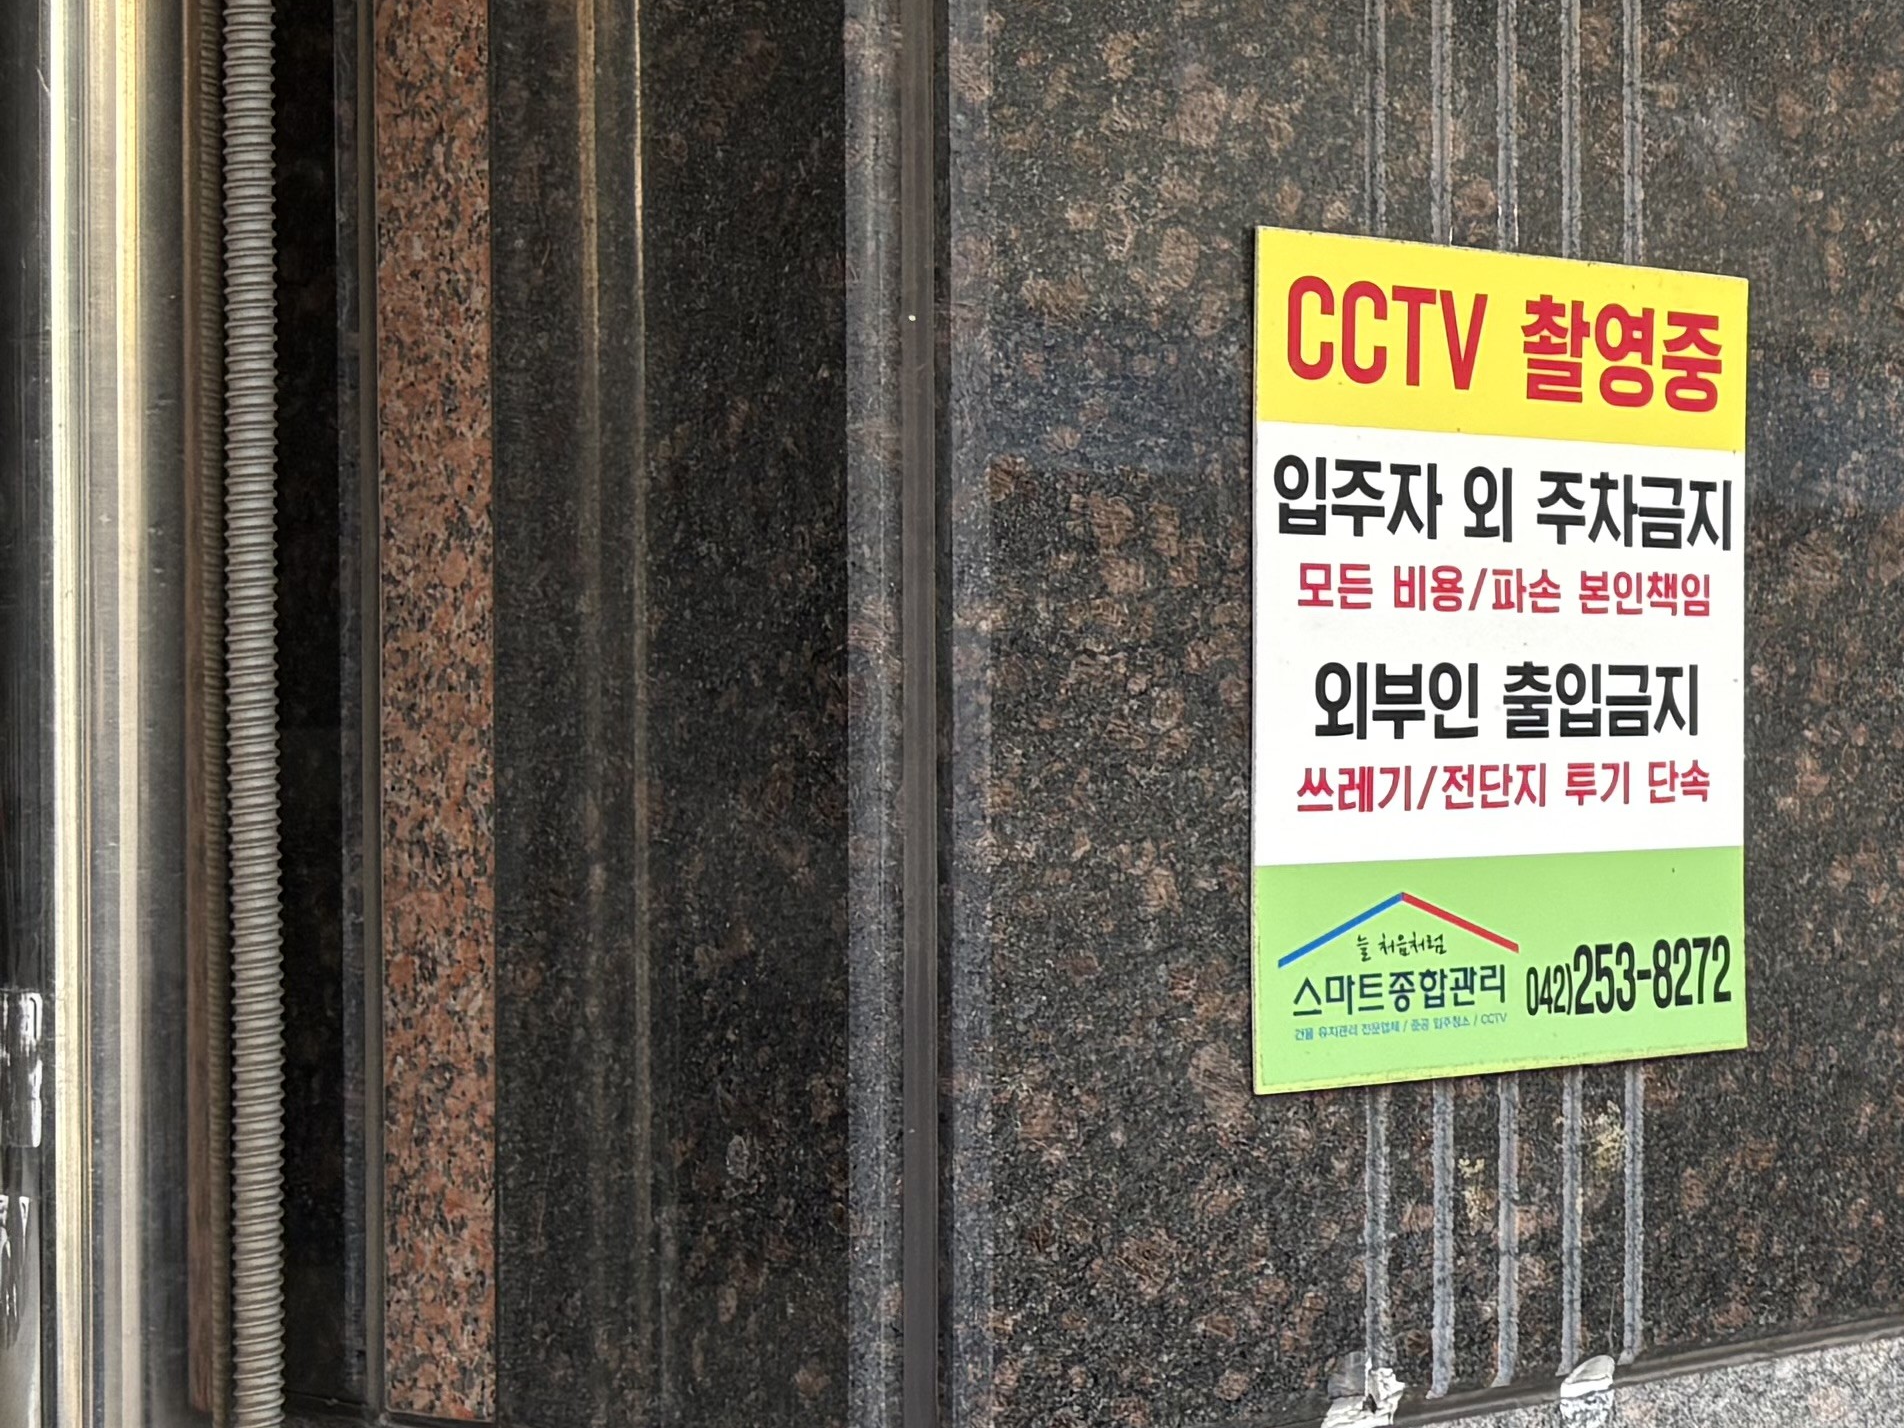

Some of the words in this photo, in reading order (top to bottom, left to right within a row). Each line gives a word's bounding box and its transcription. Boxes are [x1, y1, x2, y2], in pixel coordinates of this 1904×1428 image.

[1287, 275, 1488, 390] CCTV
[1521, 295, 1723, 413] 촬영중
[1274, 454, 1443, 539] 입주자
[1463, 466, 1513, 542] 외
[1536, 471, 1733, 551] 주차금지
[1297, 563, 1373, 609] 모든
[1393, 565, 1562, 614] 비용/파손
[1578, 570, 1710, 617] 본인책임
[1314, 661, 1478, 740] 외부인
[1502, 661, 1698, 739] 출입금지
[1296, 763, 1547, 813] 쓰레기/전단지
[1565, 761, 1630, 806] 투기
[1649, 758, 1710, 804] 단속
[1357, 935, 1371, 962] 늘
[1379, 932, 1447, 957] 처음처럼
[1526, 935, 1732, 1017] 042)253-8272
[1293, 965, 1505, 1016] 스마트종합관리
